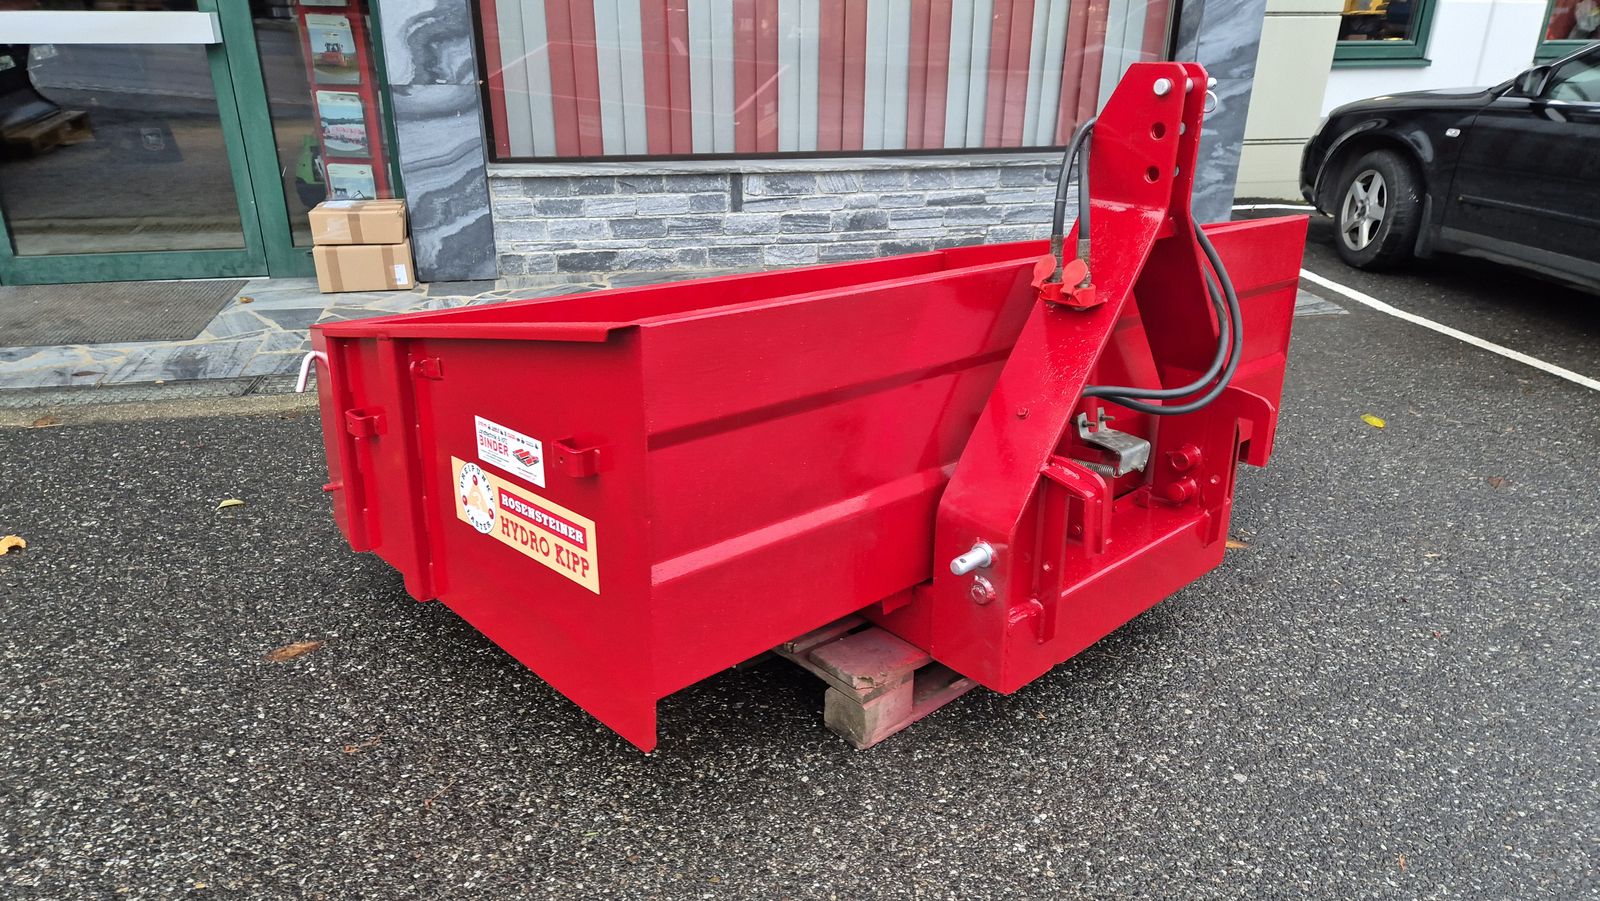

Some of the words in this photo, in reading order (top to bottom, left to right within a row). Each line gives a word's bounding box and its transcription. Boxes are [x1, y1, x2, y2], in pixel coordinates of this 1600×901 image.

[479, 435, 509, 457] BINDER
[501, 493, 584, 544] ROSENSTEINER
[500, 515, 550, 557] HYDRO
[555, 543, 589, 578] KIPP
